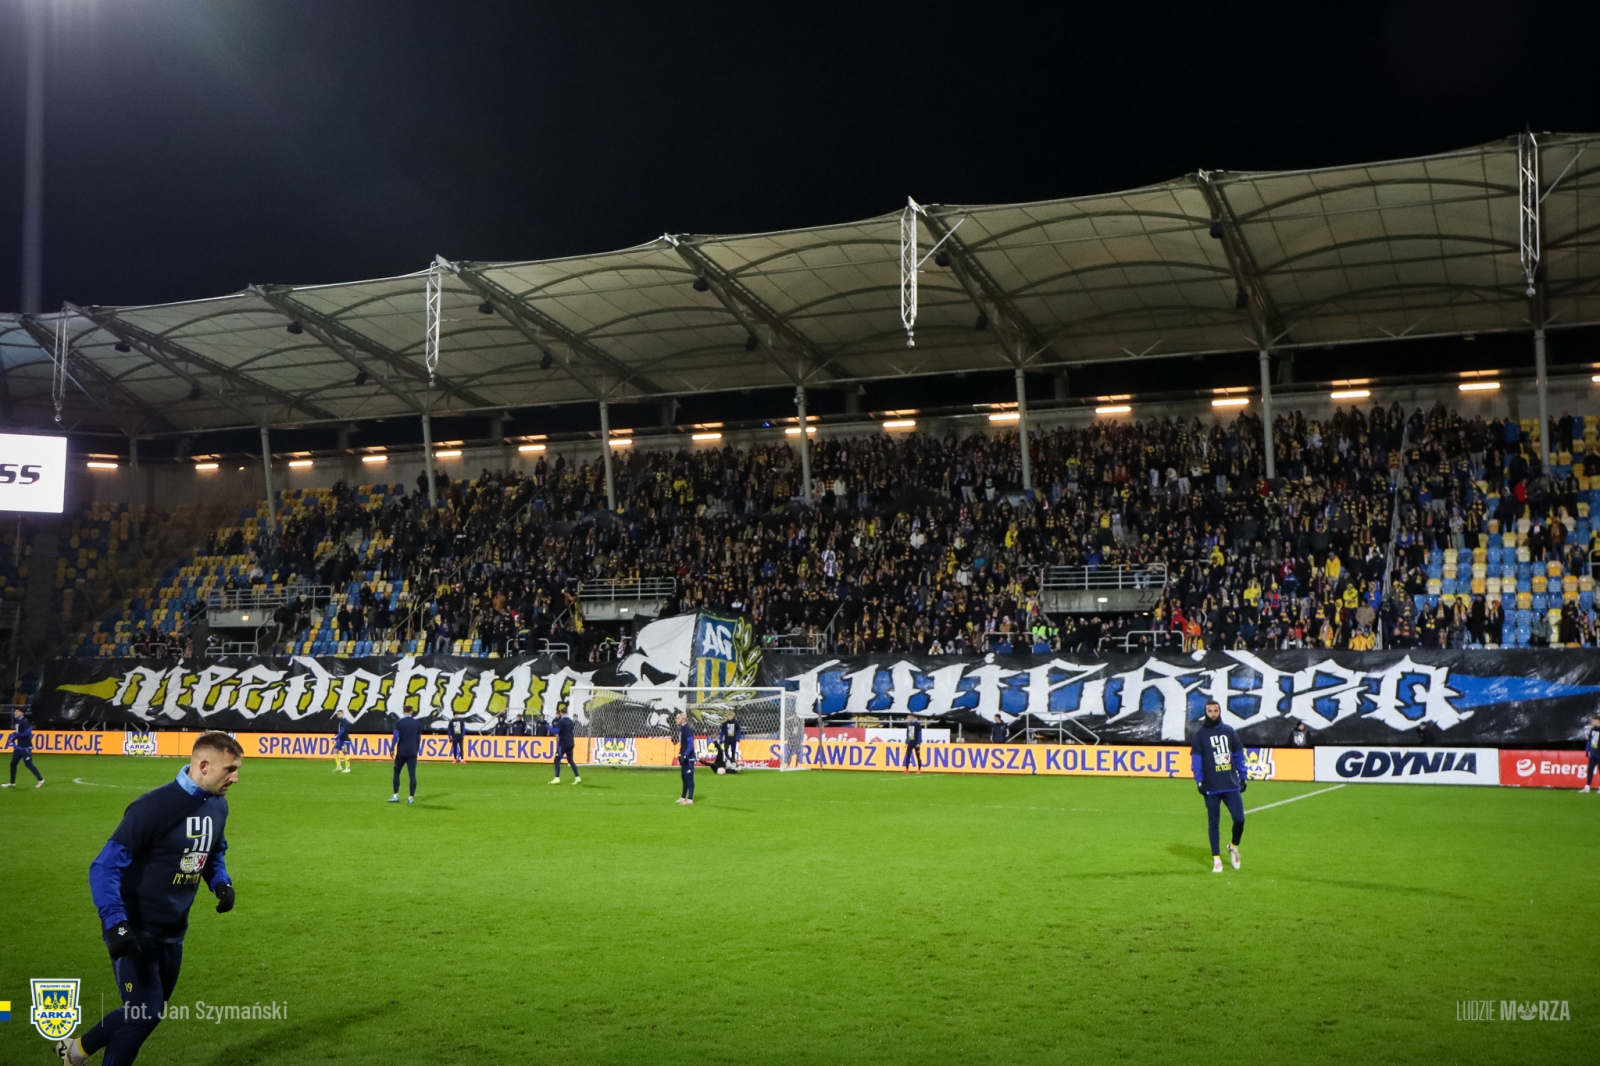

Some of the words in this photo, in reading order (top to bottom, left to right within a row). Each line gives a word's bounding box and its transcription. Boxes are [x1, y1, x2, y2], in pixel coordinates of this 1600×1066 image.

[1137, 590, 1155, 604] 22
[702, 622, 733, 660] AG
[30, 733, 103, 755] OLEKCJĘ
[467, 738, 567, 761] KOLEKCJ
[1046, 749, 1179, 778] KOLEKCJĘ
[1335, 750, 1477, 778] GDYNIA
[1540, 761, 1598, 778] Energ
[124, 982, 133, 992] 19
